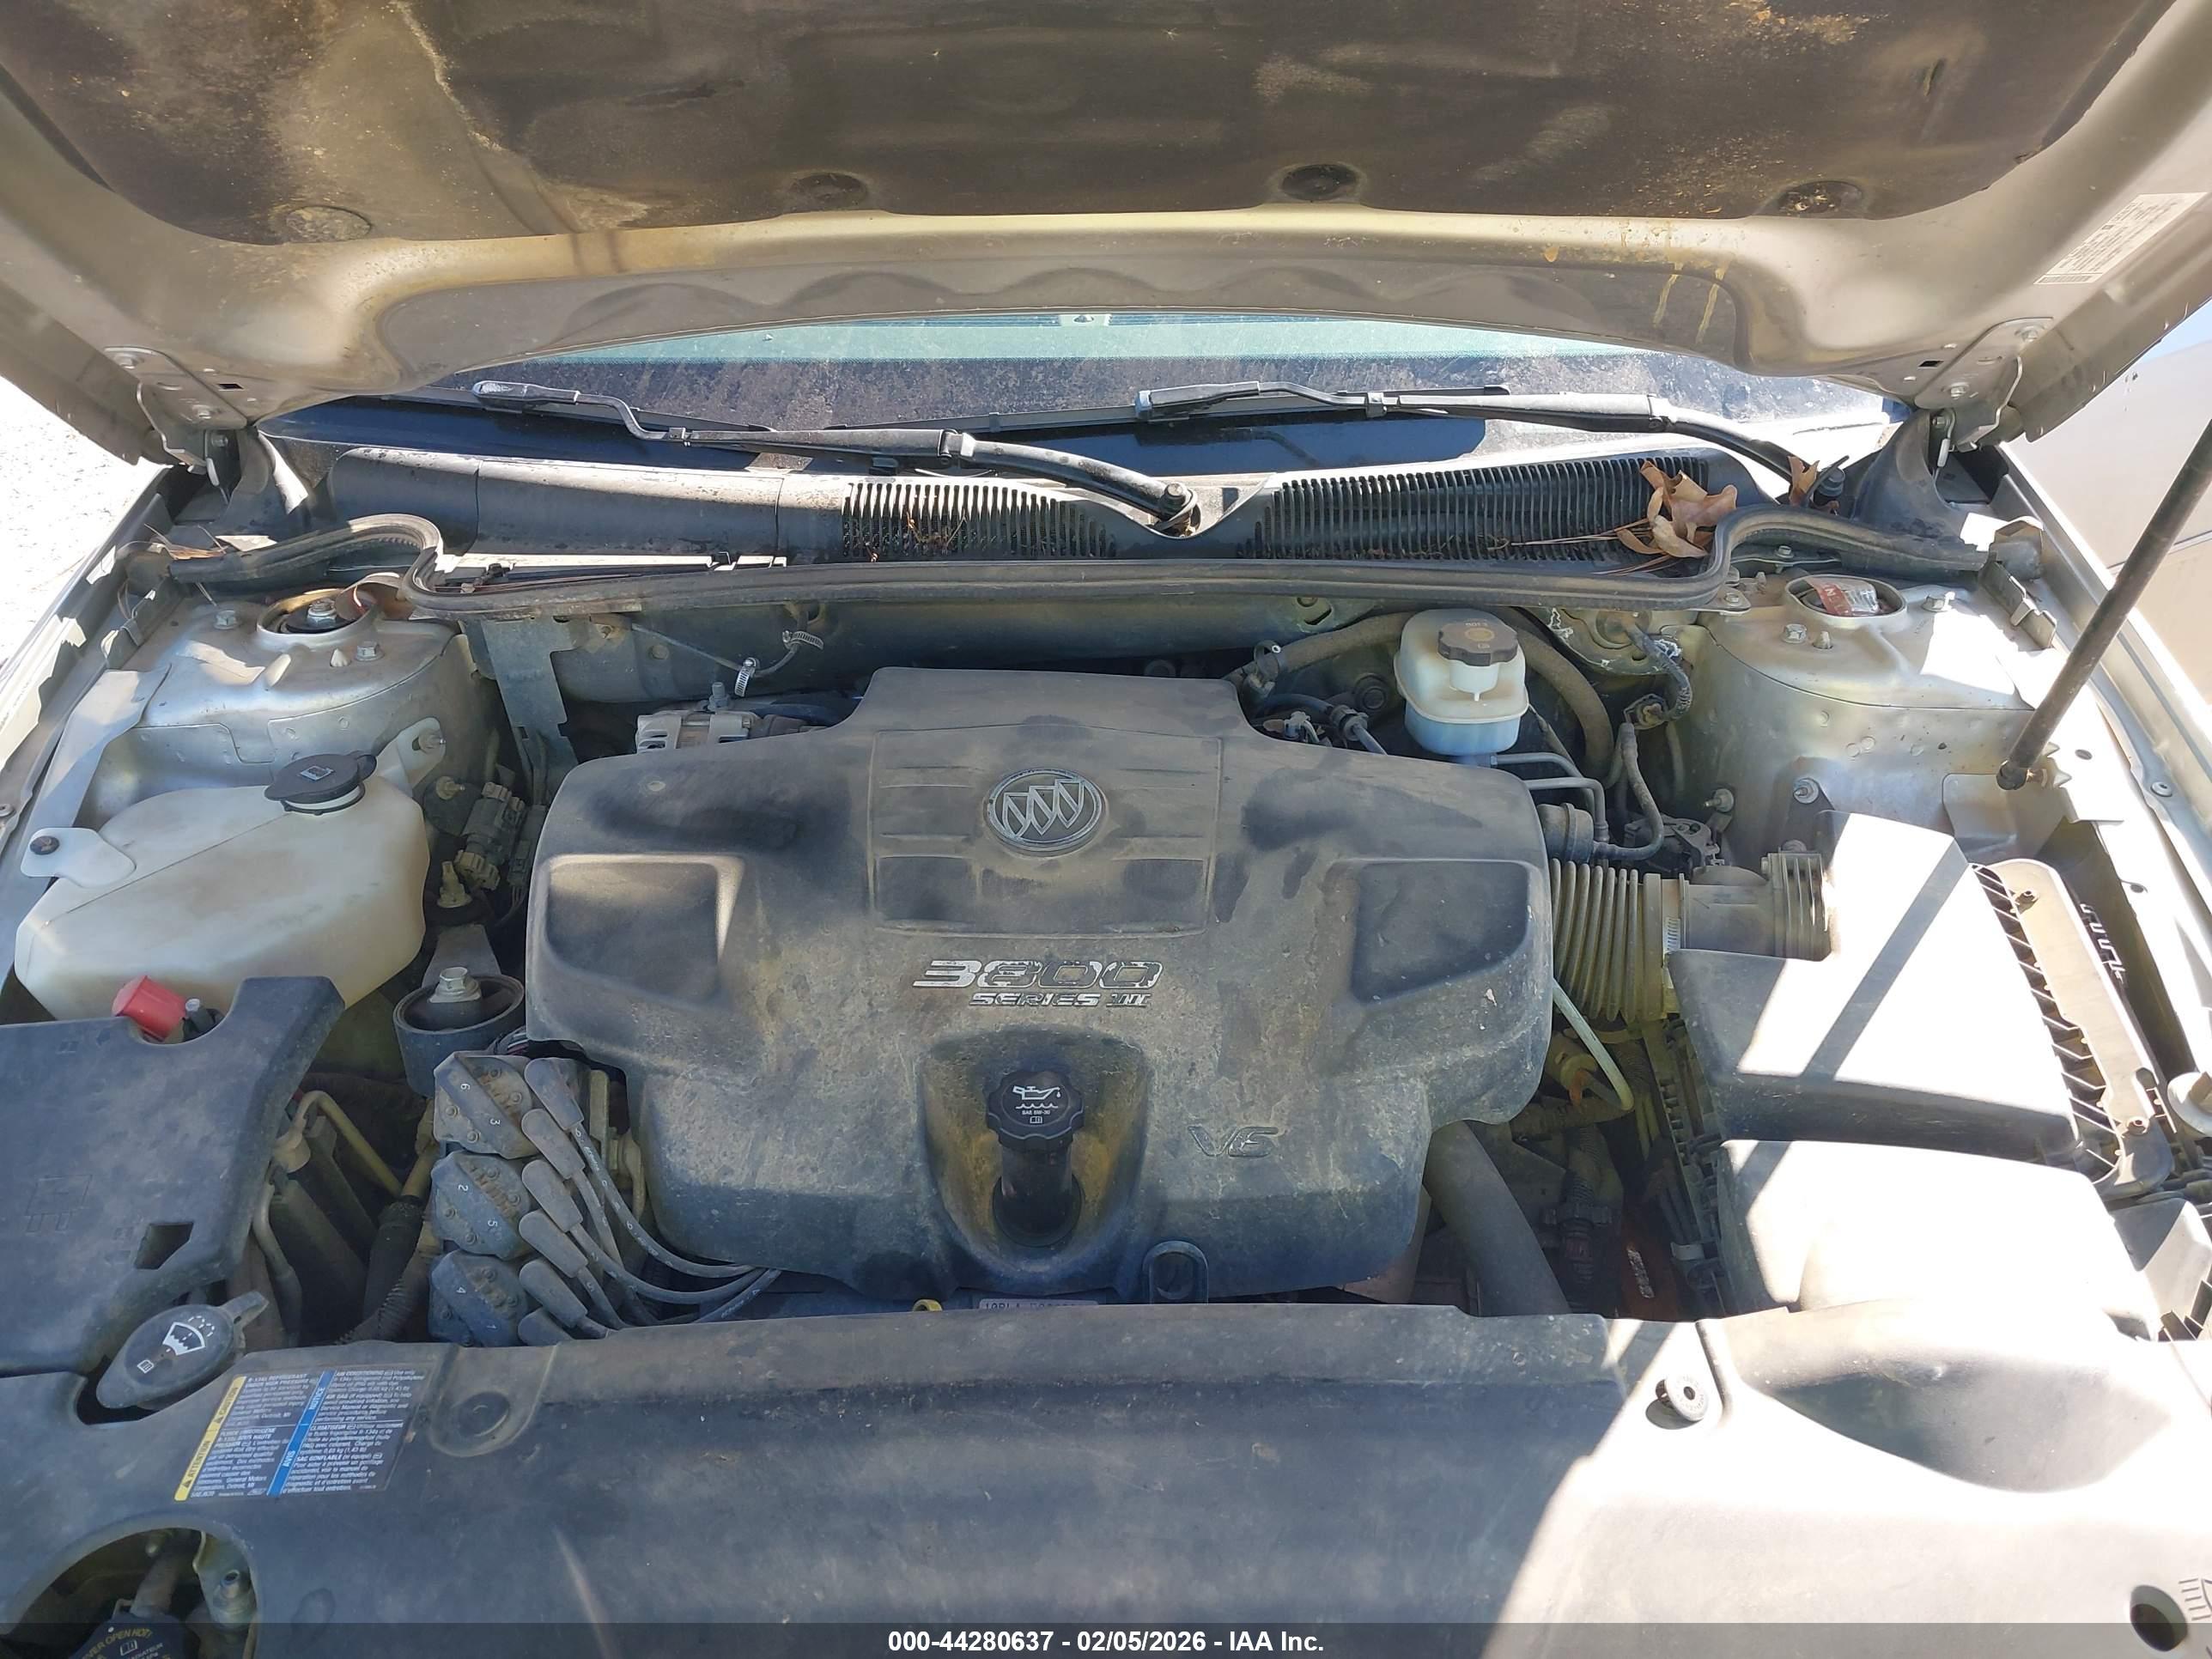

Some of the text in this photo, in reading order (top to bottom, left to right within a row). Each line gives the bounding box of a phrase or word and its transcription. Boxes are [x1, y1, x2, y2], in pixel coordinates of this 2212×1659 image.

[912, 959, 1164, 989] 3800
[969, 993, 1101, 1007] SERIES
[1187, 1126, 1279, 1158] V6
[219, 1387, 239, 1415] CAUTION
[308, 1387, 325, 1410] NOTICE
[188, 1441, 212, 1477] ATTENTION
[283, 1449, 295, 1468] AVIS
